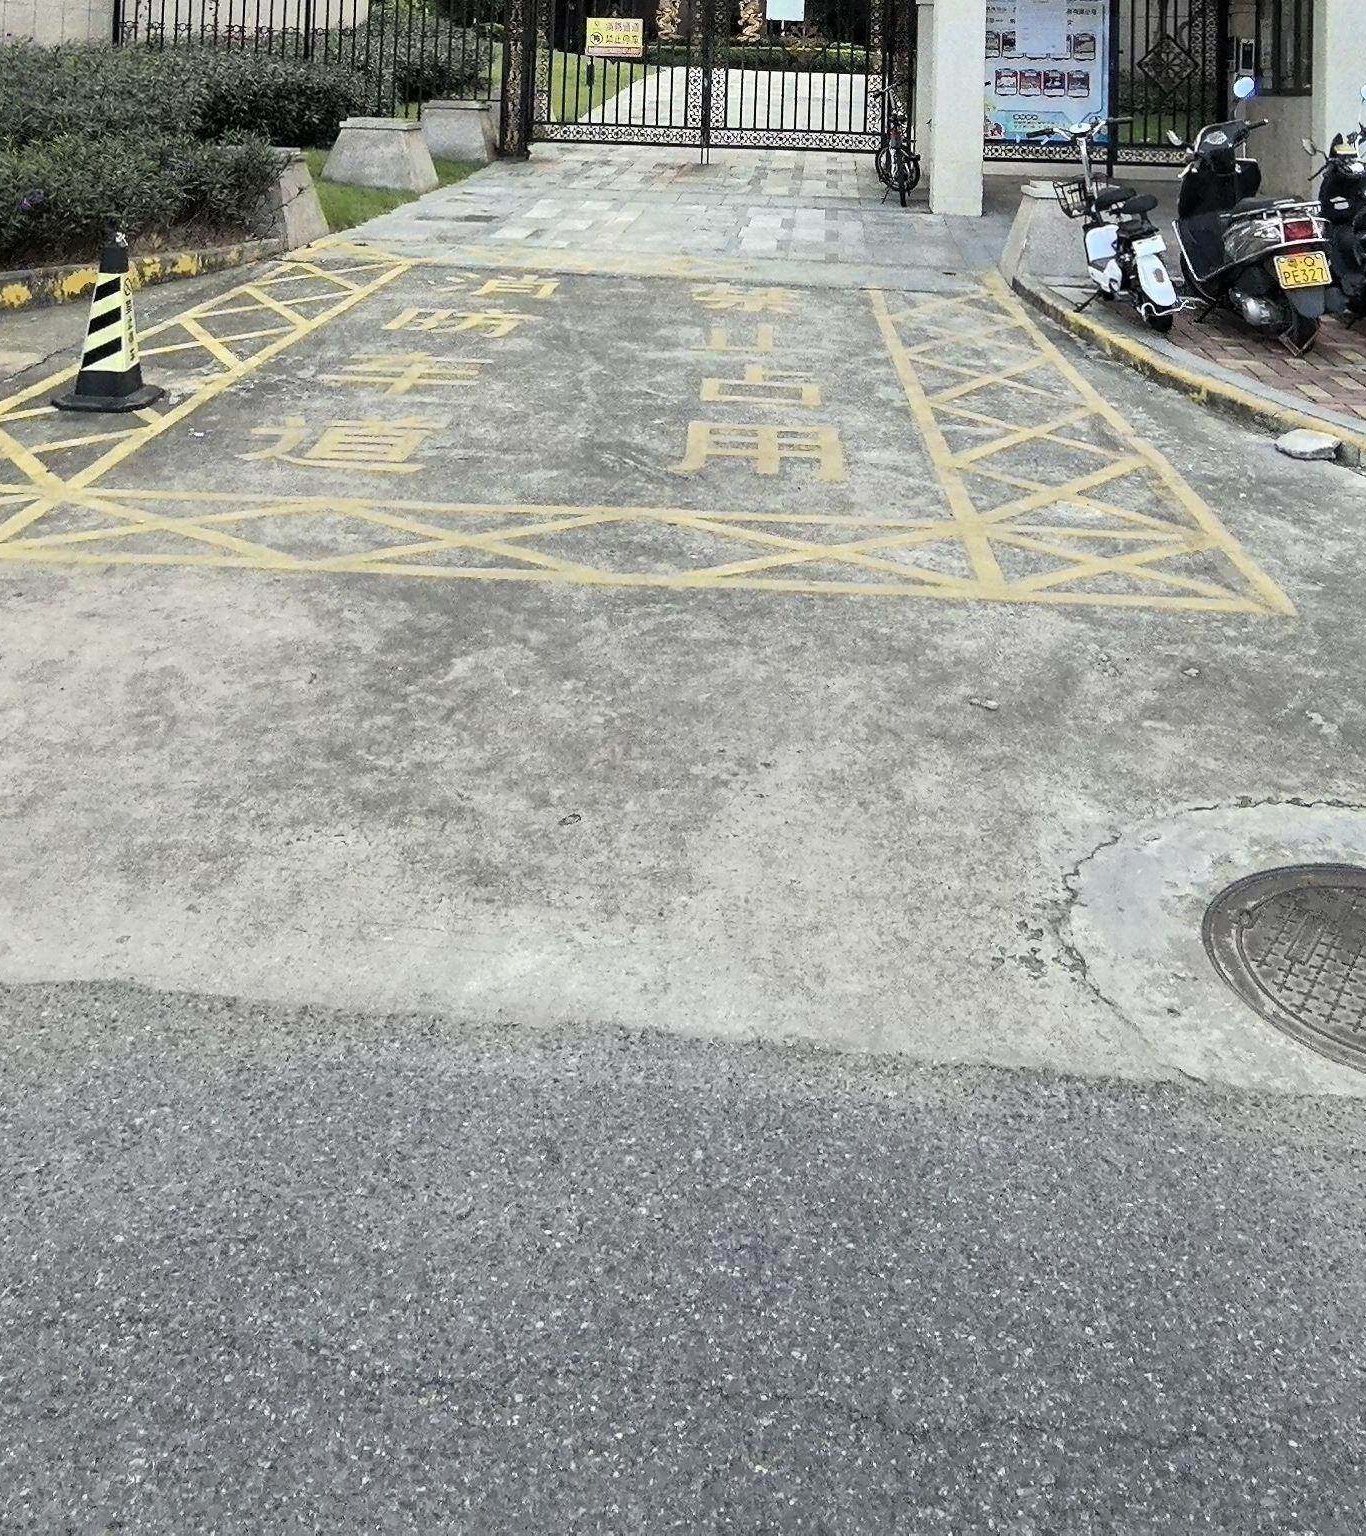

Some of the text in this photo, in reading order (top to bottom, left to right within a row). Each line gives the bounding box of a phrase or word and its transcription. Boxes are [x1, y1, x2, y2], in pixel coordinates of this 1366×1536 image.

[236, 274, 561, 474] 消防车道
[1283, 267, 1326, 285] PE327
[669, 282, 848, 483] 禁止占用
